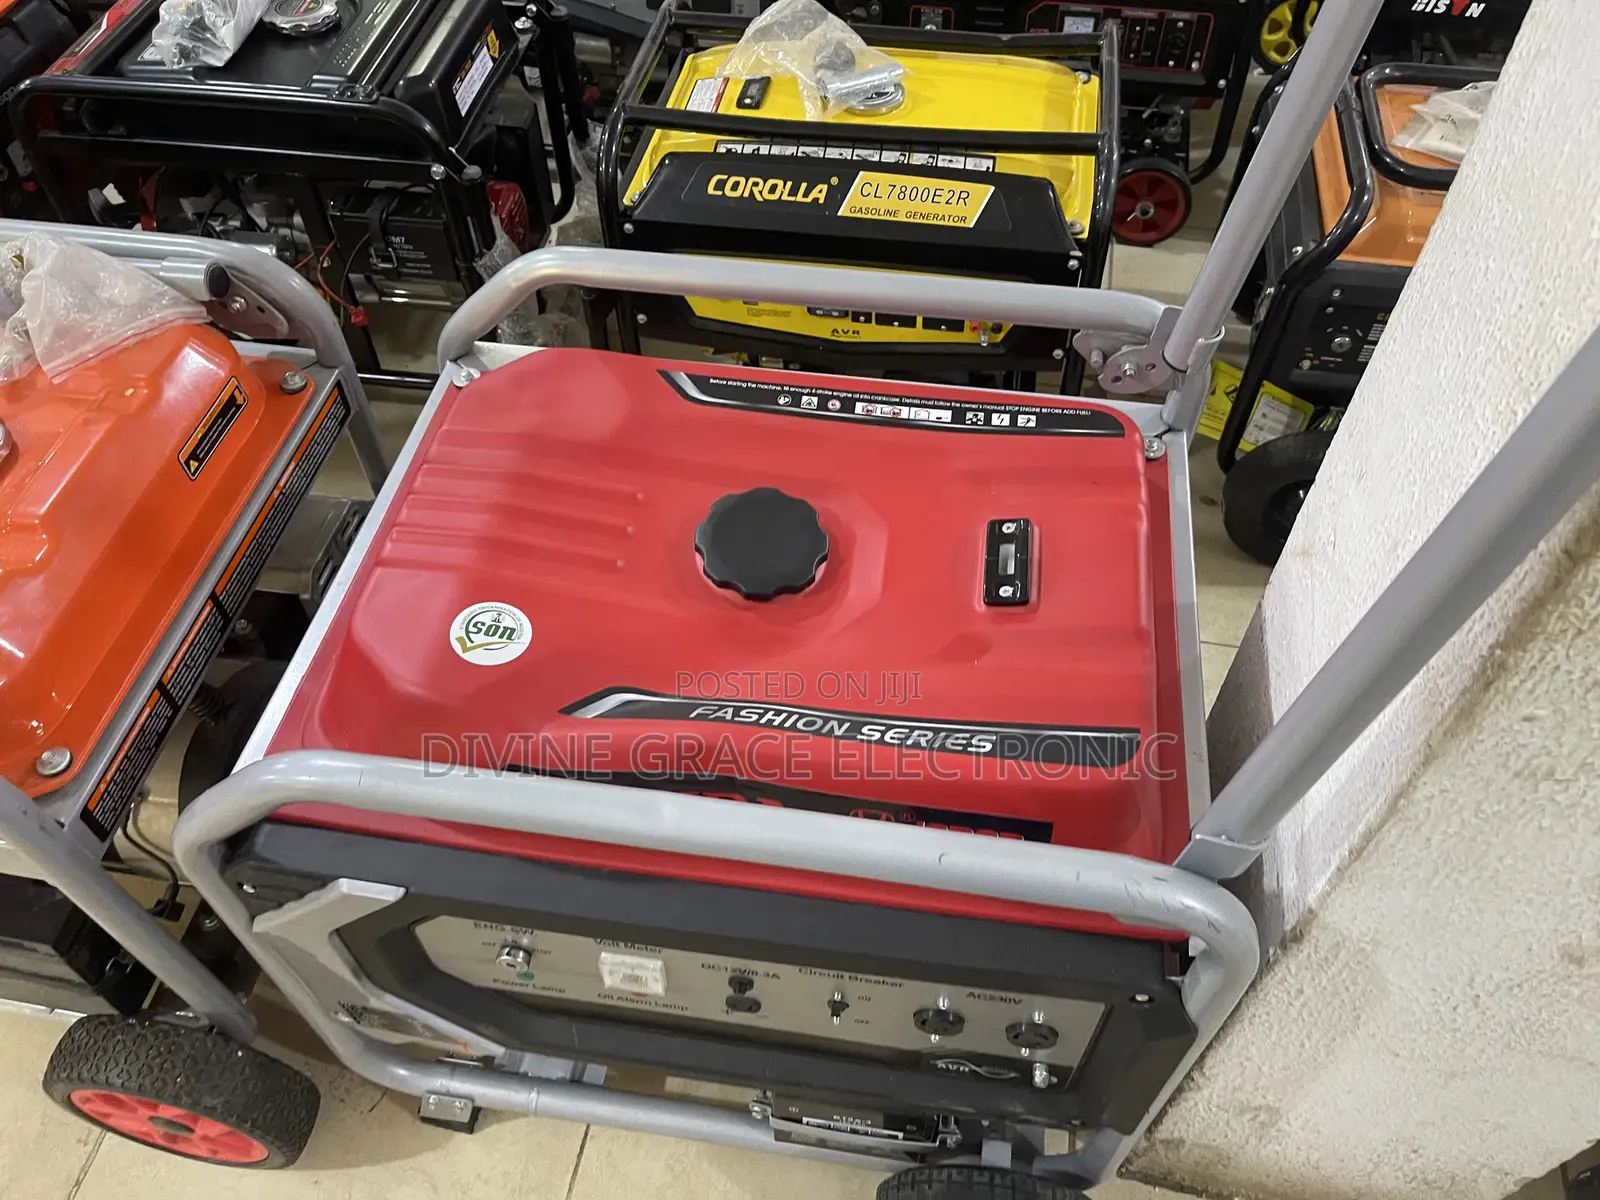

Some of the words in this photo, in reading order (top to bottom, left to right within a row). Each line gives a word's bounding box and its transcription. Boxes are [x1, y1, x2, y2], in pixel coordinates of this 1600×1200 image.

[860, 181, 971, 207] CL7800E2R
[849, 205, 901, 218] GASOLINE
[905, 210, 968, 224] GENERATOR
[689, 704, 851, 737] FASHION
[856, 725, 997, 754] SERIES
[798, 967, 845, 981] Circuit
